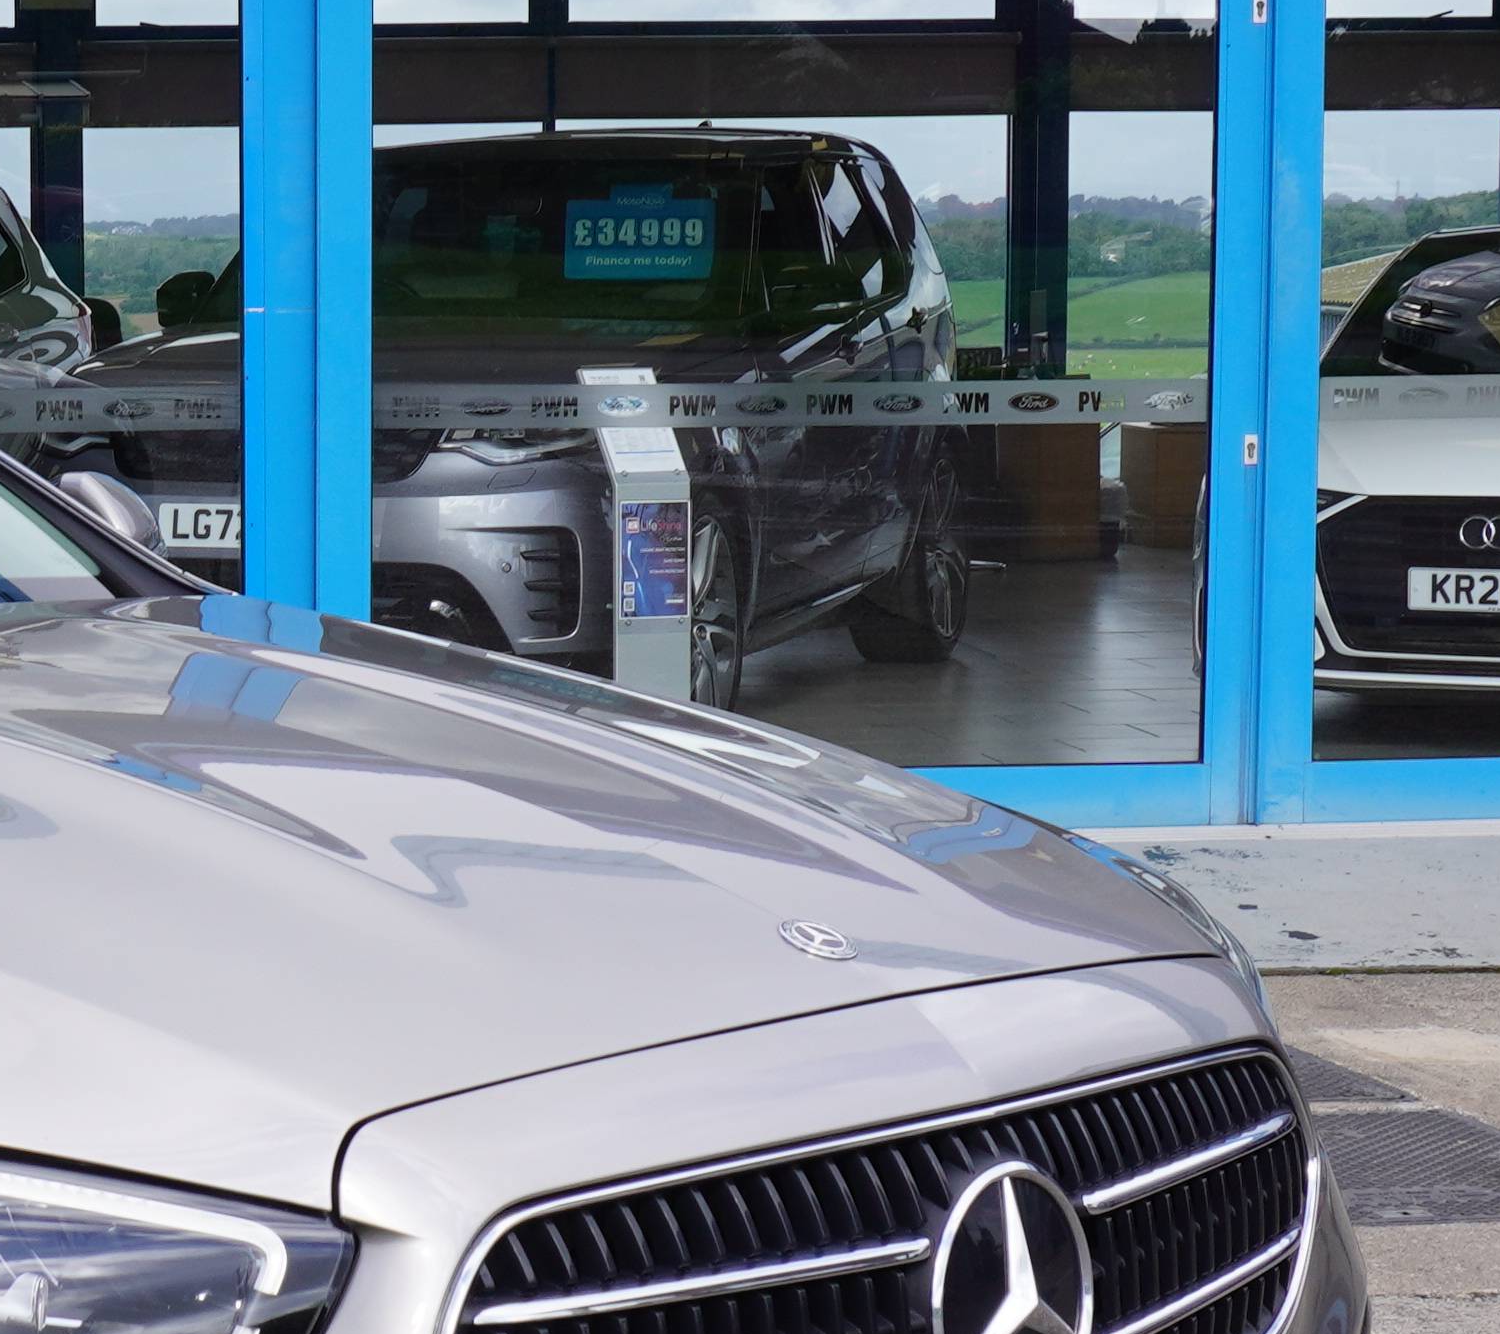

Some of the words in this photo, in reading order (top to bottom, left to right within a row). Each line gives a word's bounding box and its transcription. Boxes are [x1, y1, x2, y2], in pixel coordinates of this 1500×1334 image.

[574, 217, 704, 247] £34999
[584, 255, 628, 266] Finance
[633, 257, 652, 266] me
[654, 255, 692, 267] today!
[35, 399, 84, 421] PWM
[668, 394, 717, 417] PWM
[805, 393, 854, 415] PWM
[942, 392, 990, 414] PWM
[172, 508, 241, 541] LG7
